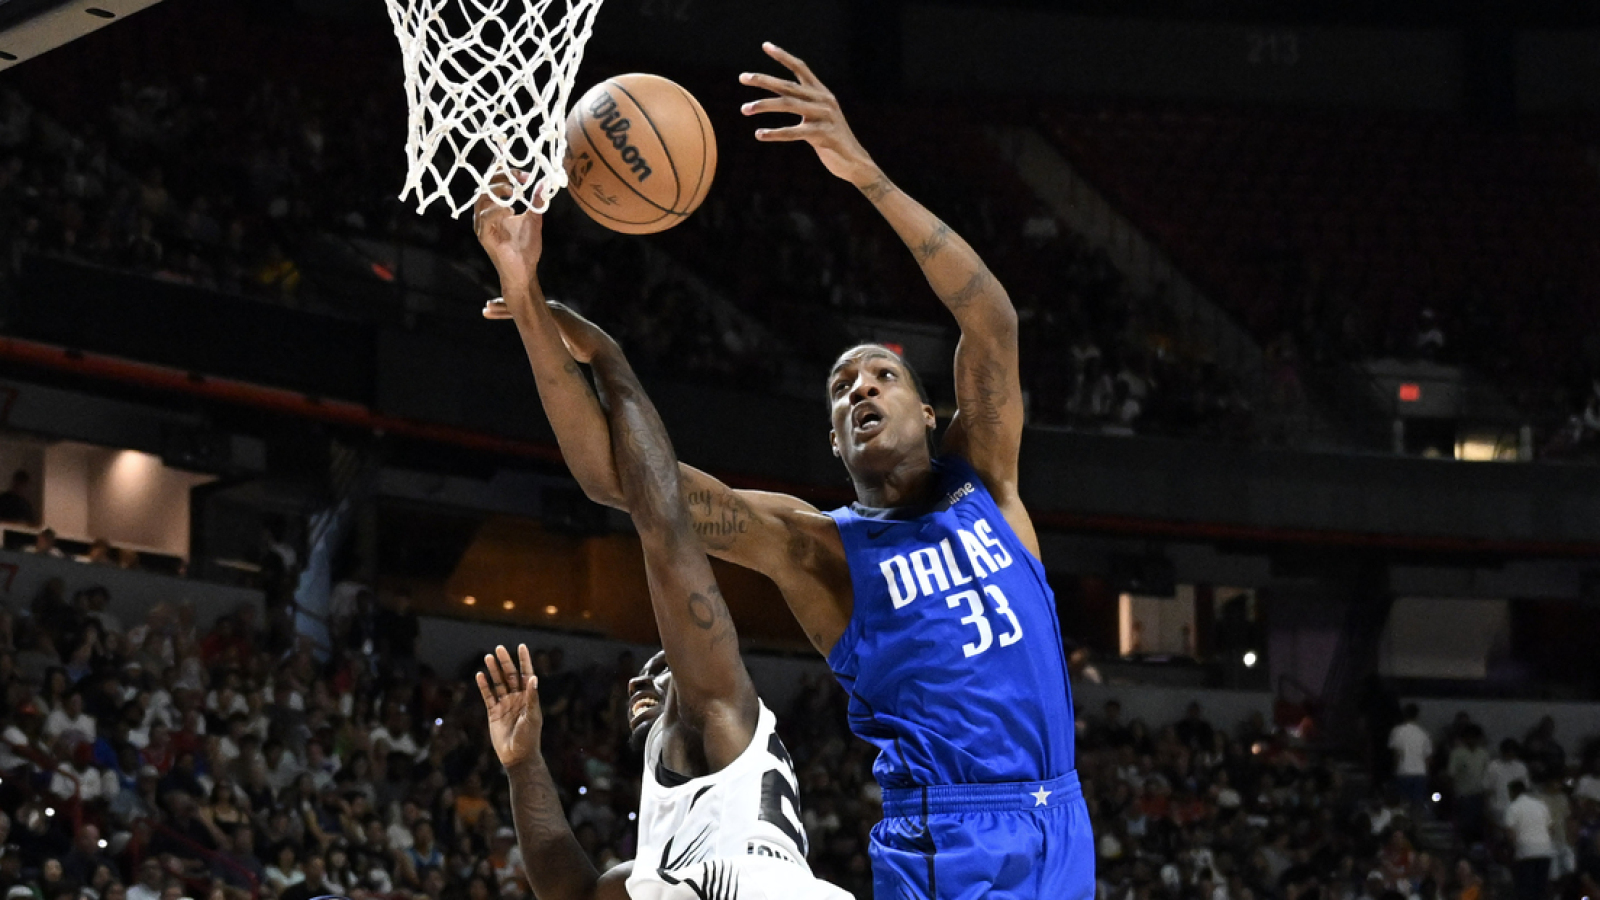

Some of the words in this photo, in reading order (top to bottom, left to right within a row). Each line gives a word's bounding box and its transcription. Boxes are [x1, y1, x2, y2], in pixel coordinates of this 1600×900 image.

[590, 91, 652, 183] Wilson
[692, 511, 748, 537] umble
[879, 518, 1013, 610] DALAS
[946, 584, 1023, 658] 33
